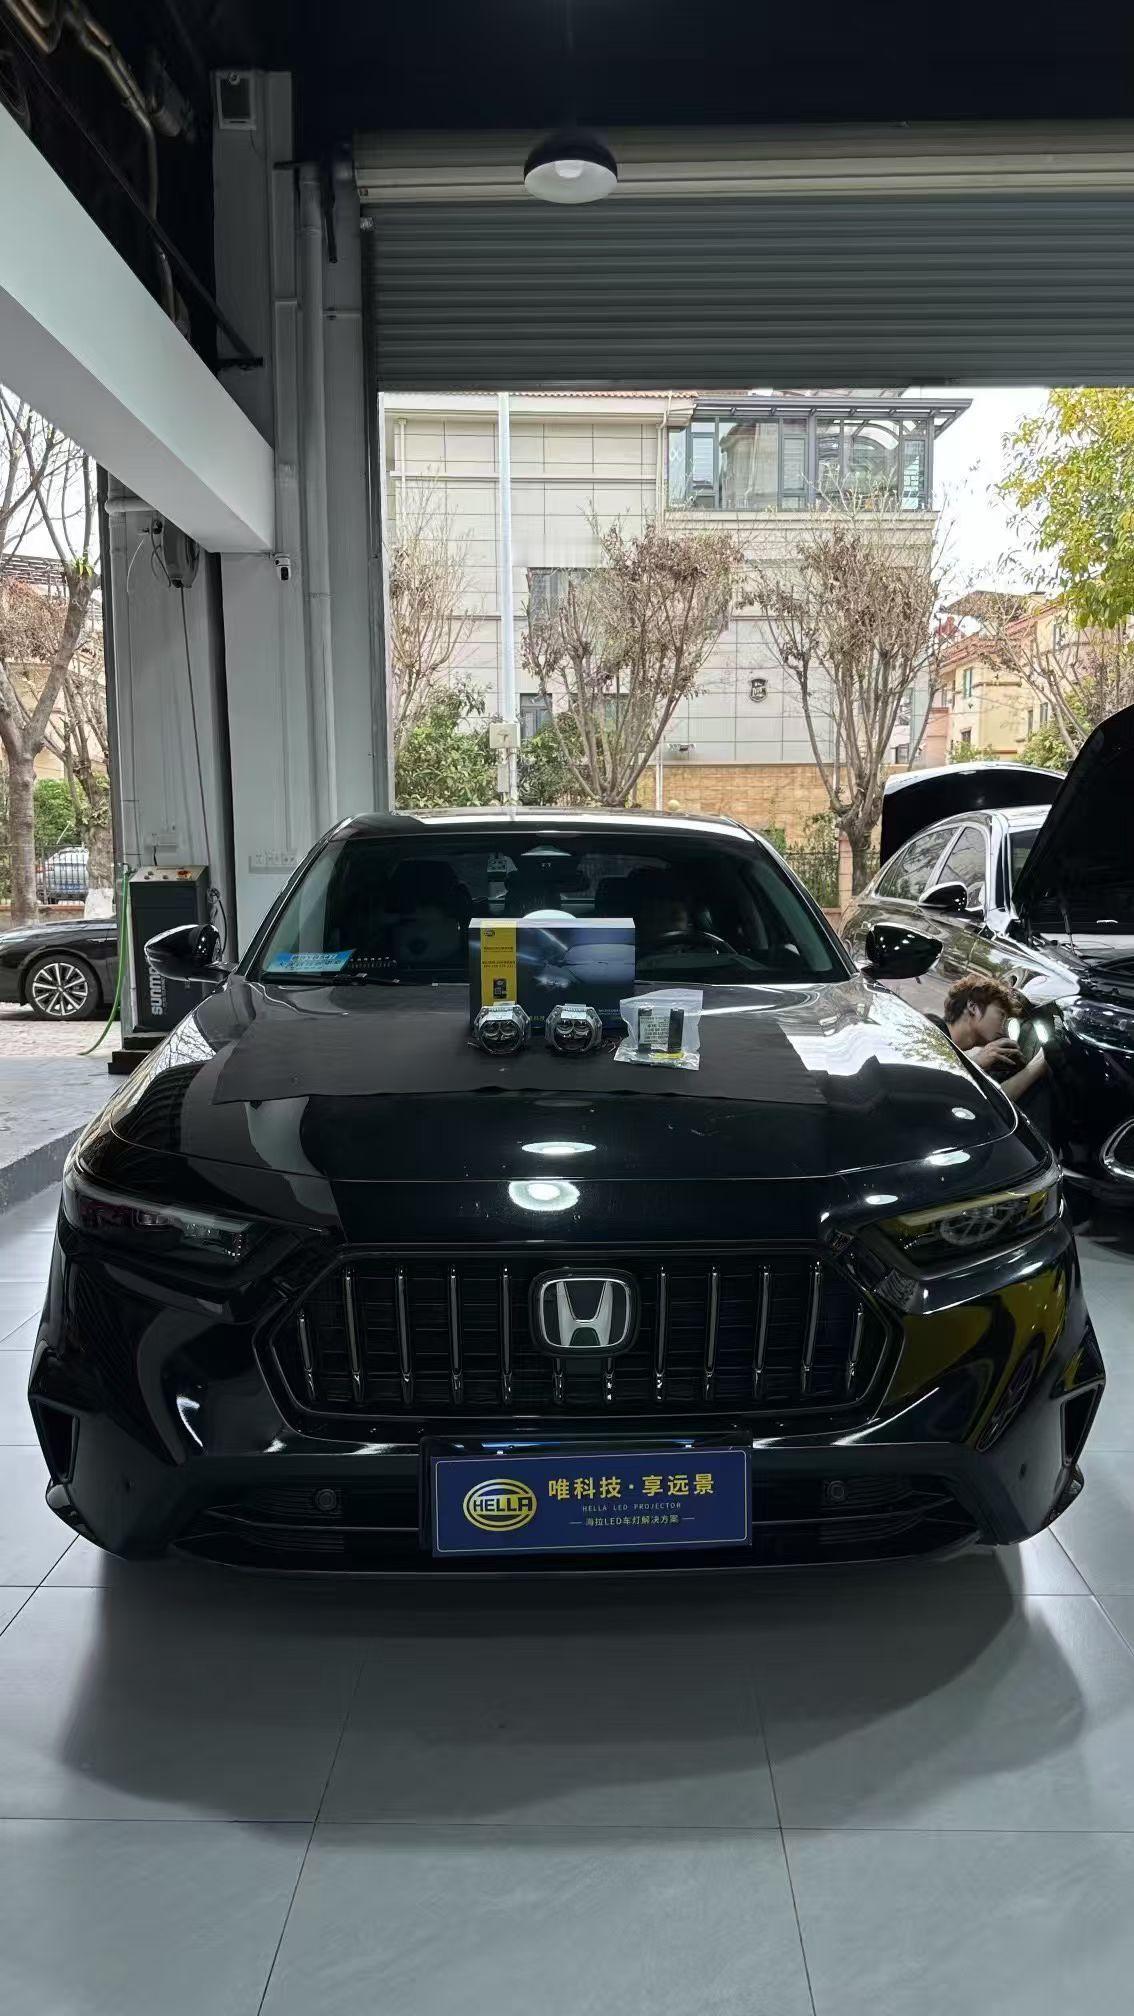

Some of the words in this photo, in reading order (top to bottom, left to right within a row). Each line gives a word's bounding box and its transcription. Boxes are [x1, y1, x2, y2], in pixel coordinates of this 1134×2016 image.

[548, 1473, 714, 1500] 唯科技·享远景
[473, 1495, 533, 1515] HELLA
[582, 1504, 608, 1512] HELLA
[633, 1502, 682, 1510] PROJECTOR
